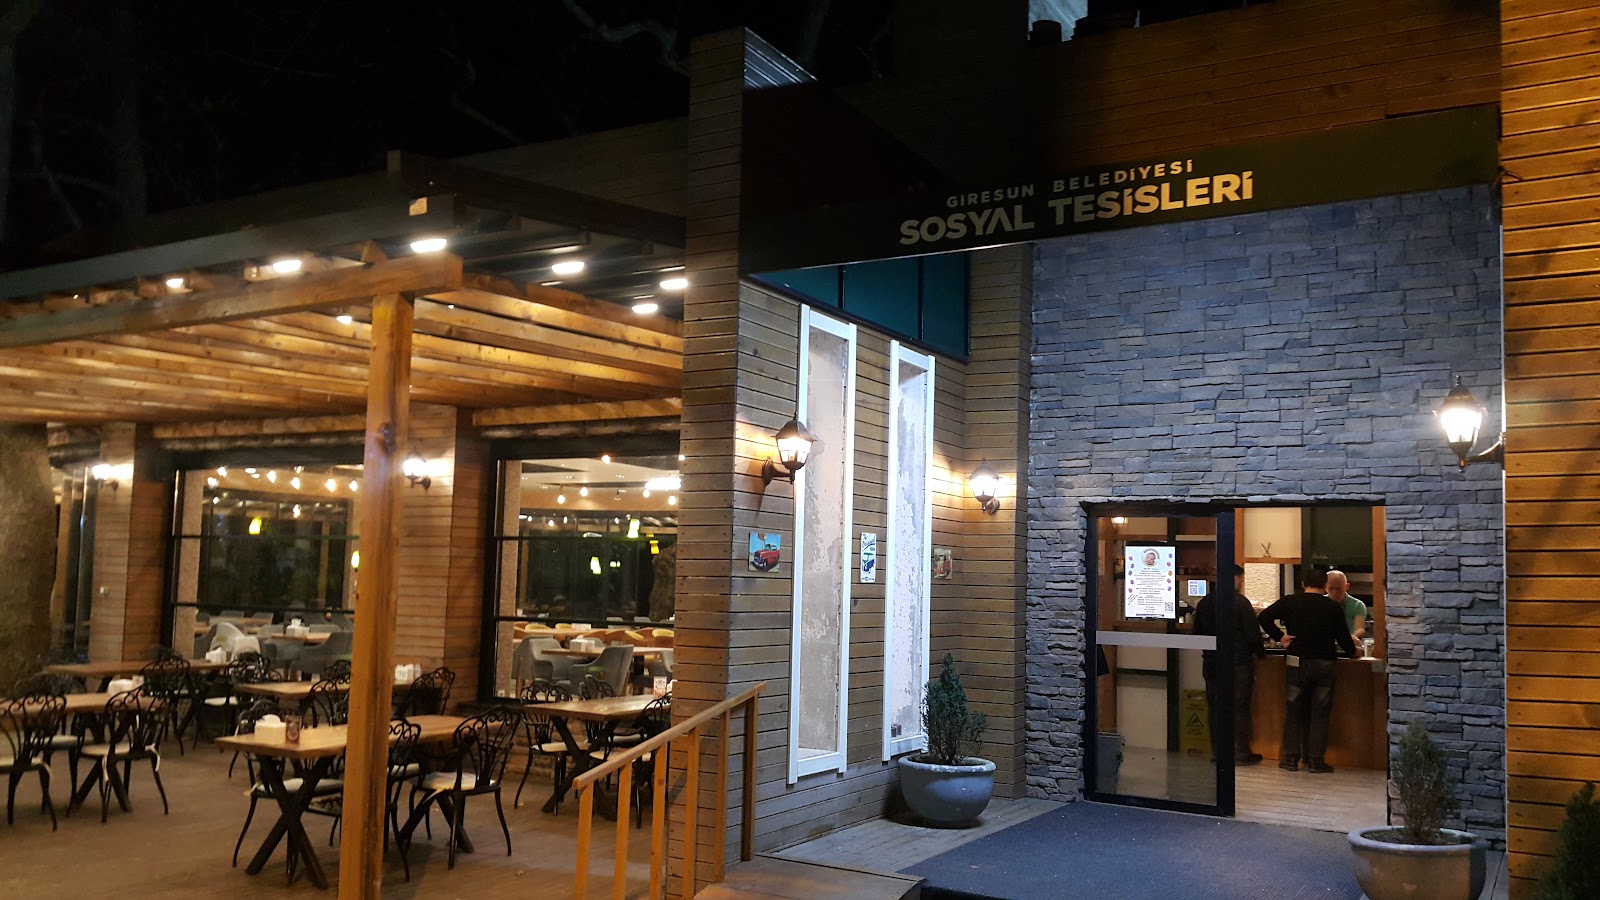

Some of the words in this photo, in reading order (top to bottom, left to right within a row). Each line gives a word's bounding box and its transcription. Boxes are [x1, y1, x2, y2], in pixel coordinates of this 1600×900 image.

[900, 204, 1035, 245] SOSYAL
[1048, 171, 1254, 225] TESİSLERİ
[946, 184, 1034, 208] GIRESUN
[1053, 159, 1193, 193] BELEDİYESİ
